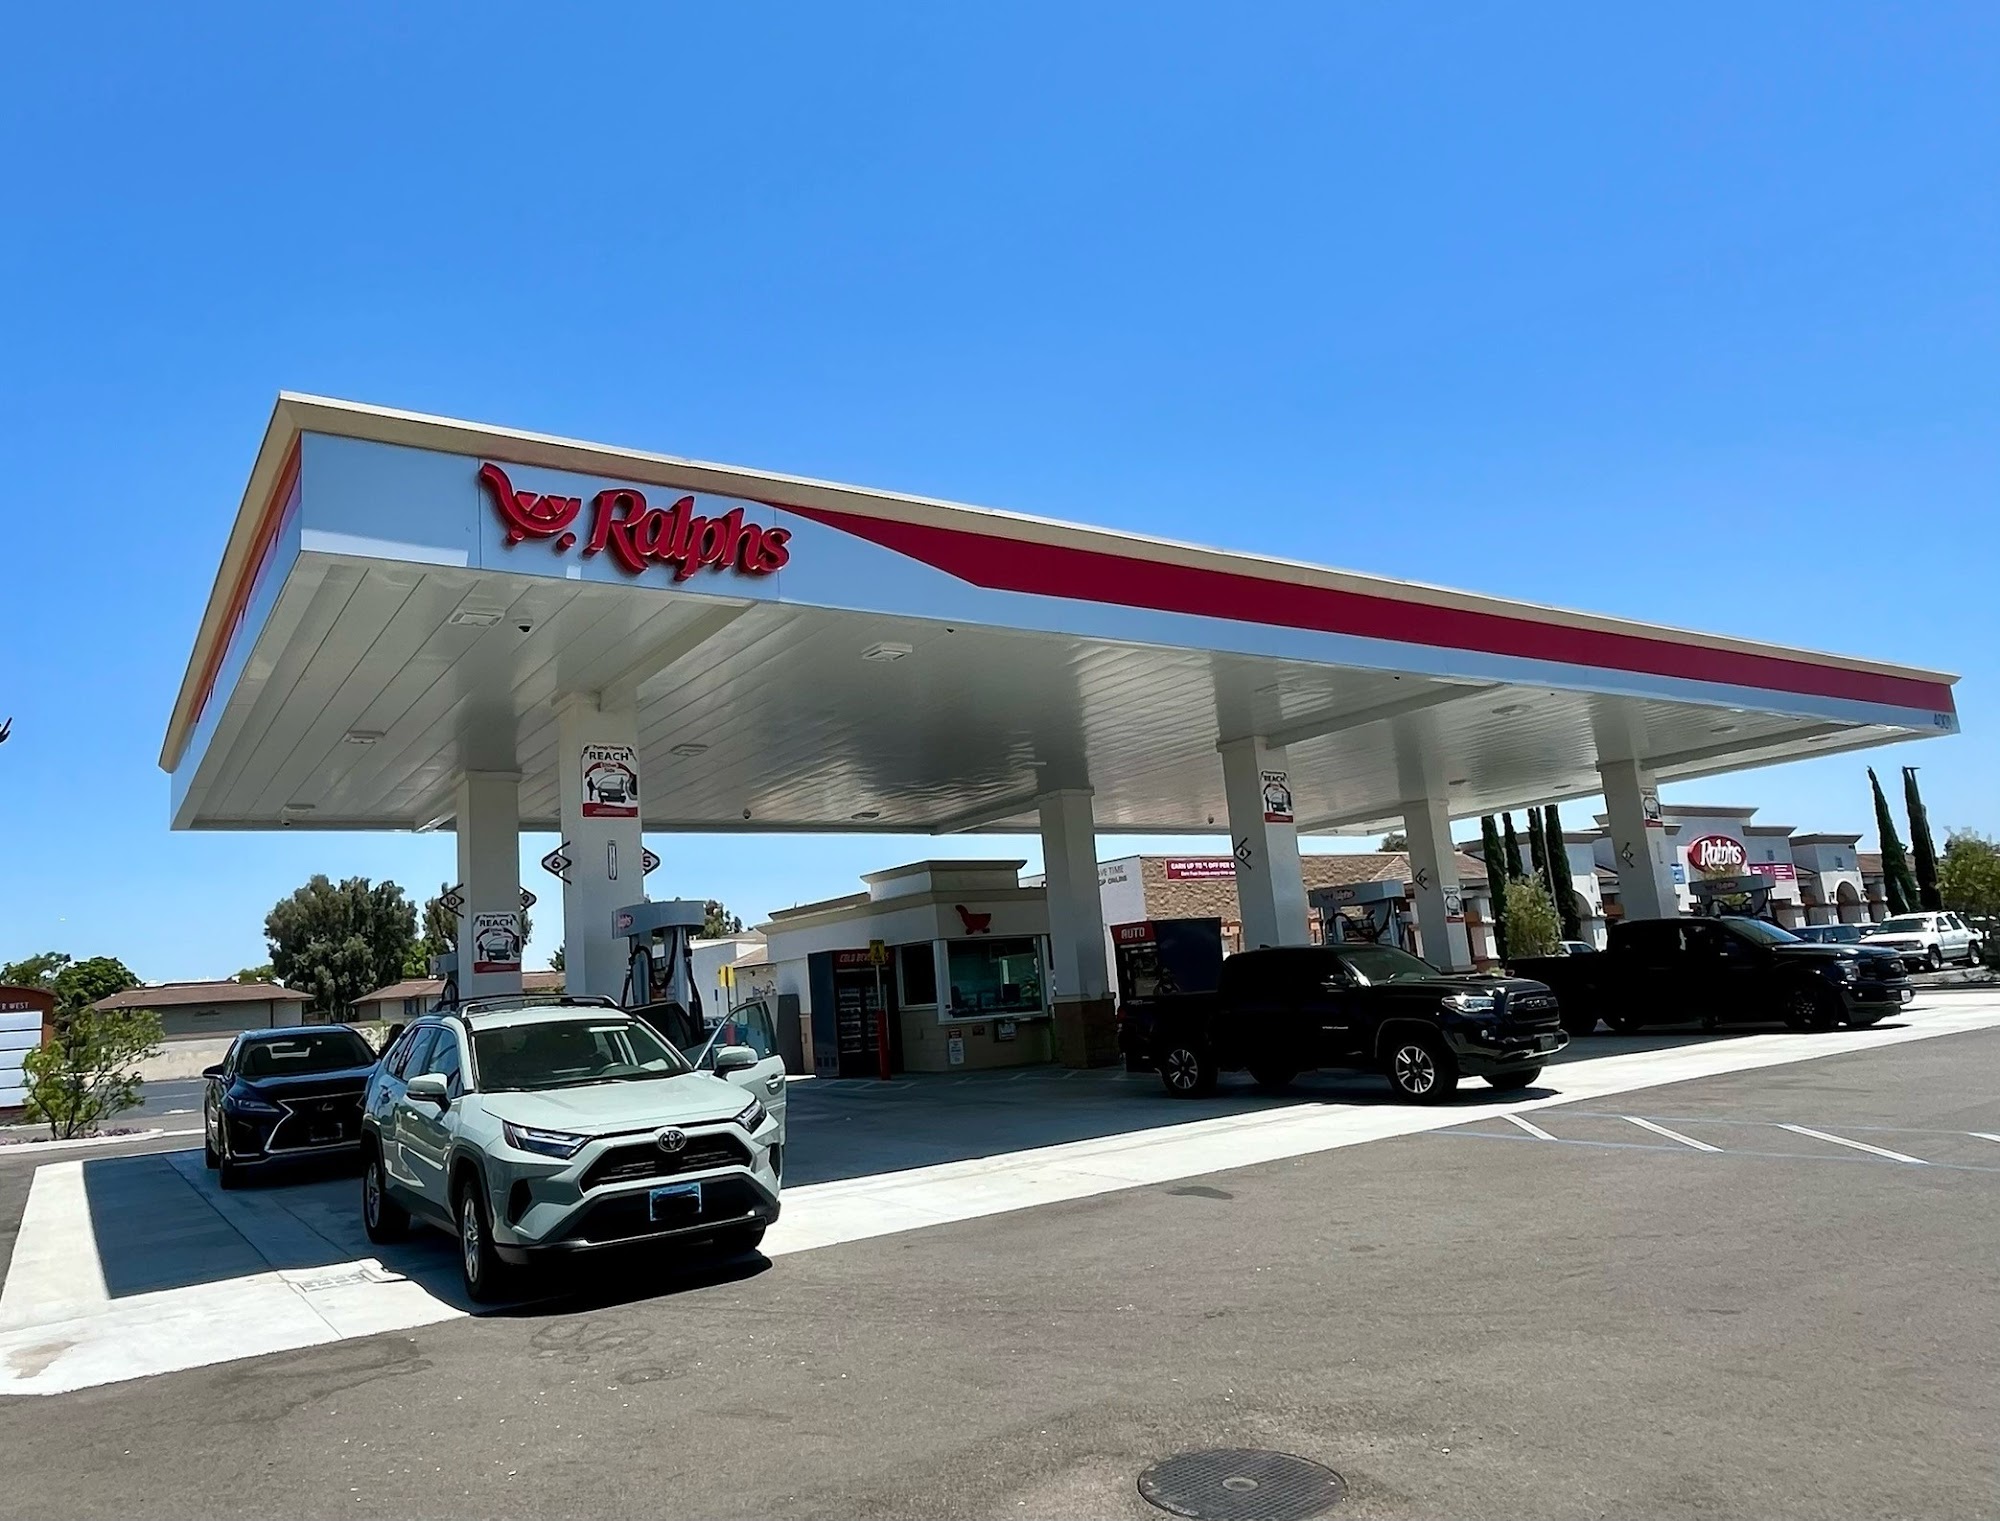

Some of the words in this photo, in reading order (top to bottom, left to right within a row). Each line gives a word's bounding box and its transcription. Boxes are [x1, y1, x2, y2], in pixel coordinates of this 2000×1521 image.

[582, 488, 792, 582] Ralphs
[589, 751, 629, 761] REACH
[1700, 839, 1742, 872] Ralphs
[551, 856, 561, 869] 6
[642, 856, 652, 868] 5
[1187, 862, 1194, 870] UP
[1195, 862, 1203, 870] TO
[1108, 865, 1124, 874] TIME
[446, 896, 457, 906] 10
[522, 895, 530, 904] 9
[480, 919, 513, 927] REACH
[1121, 926, 1146, 939] AUTO
[9, 1001, 29, 1010] WEST
